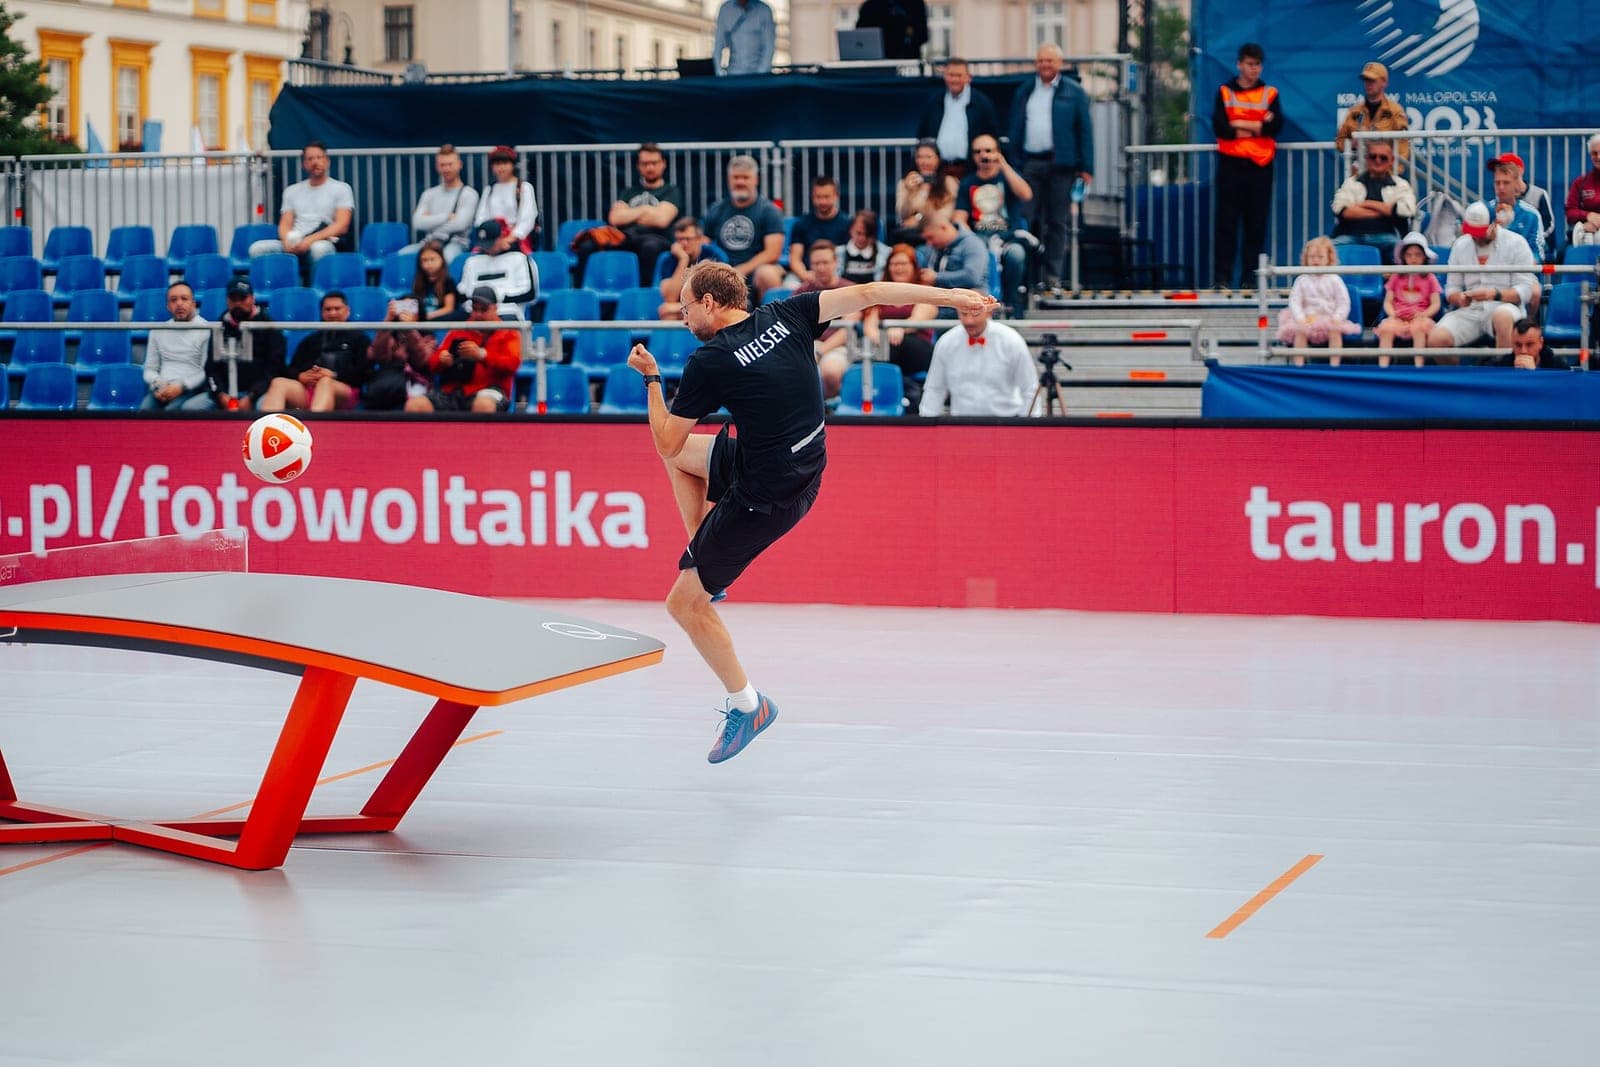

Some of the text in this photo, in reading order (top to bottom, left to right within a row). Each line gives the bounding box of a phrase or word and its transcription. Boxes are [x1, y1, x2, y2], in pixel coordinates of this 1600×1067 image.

[1337, 91, 1497, 105] KRAW MAŁOPOLSKA
[733, 320, 791, 367] NIELSEN
[0, 463, 649, 559] .pl/fotowoltaika
[1244, 486, 1600, 589] tauron.
